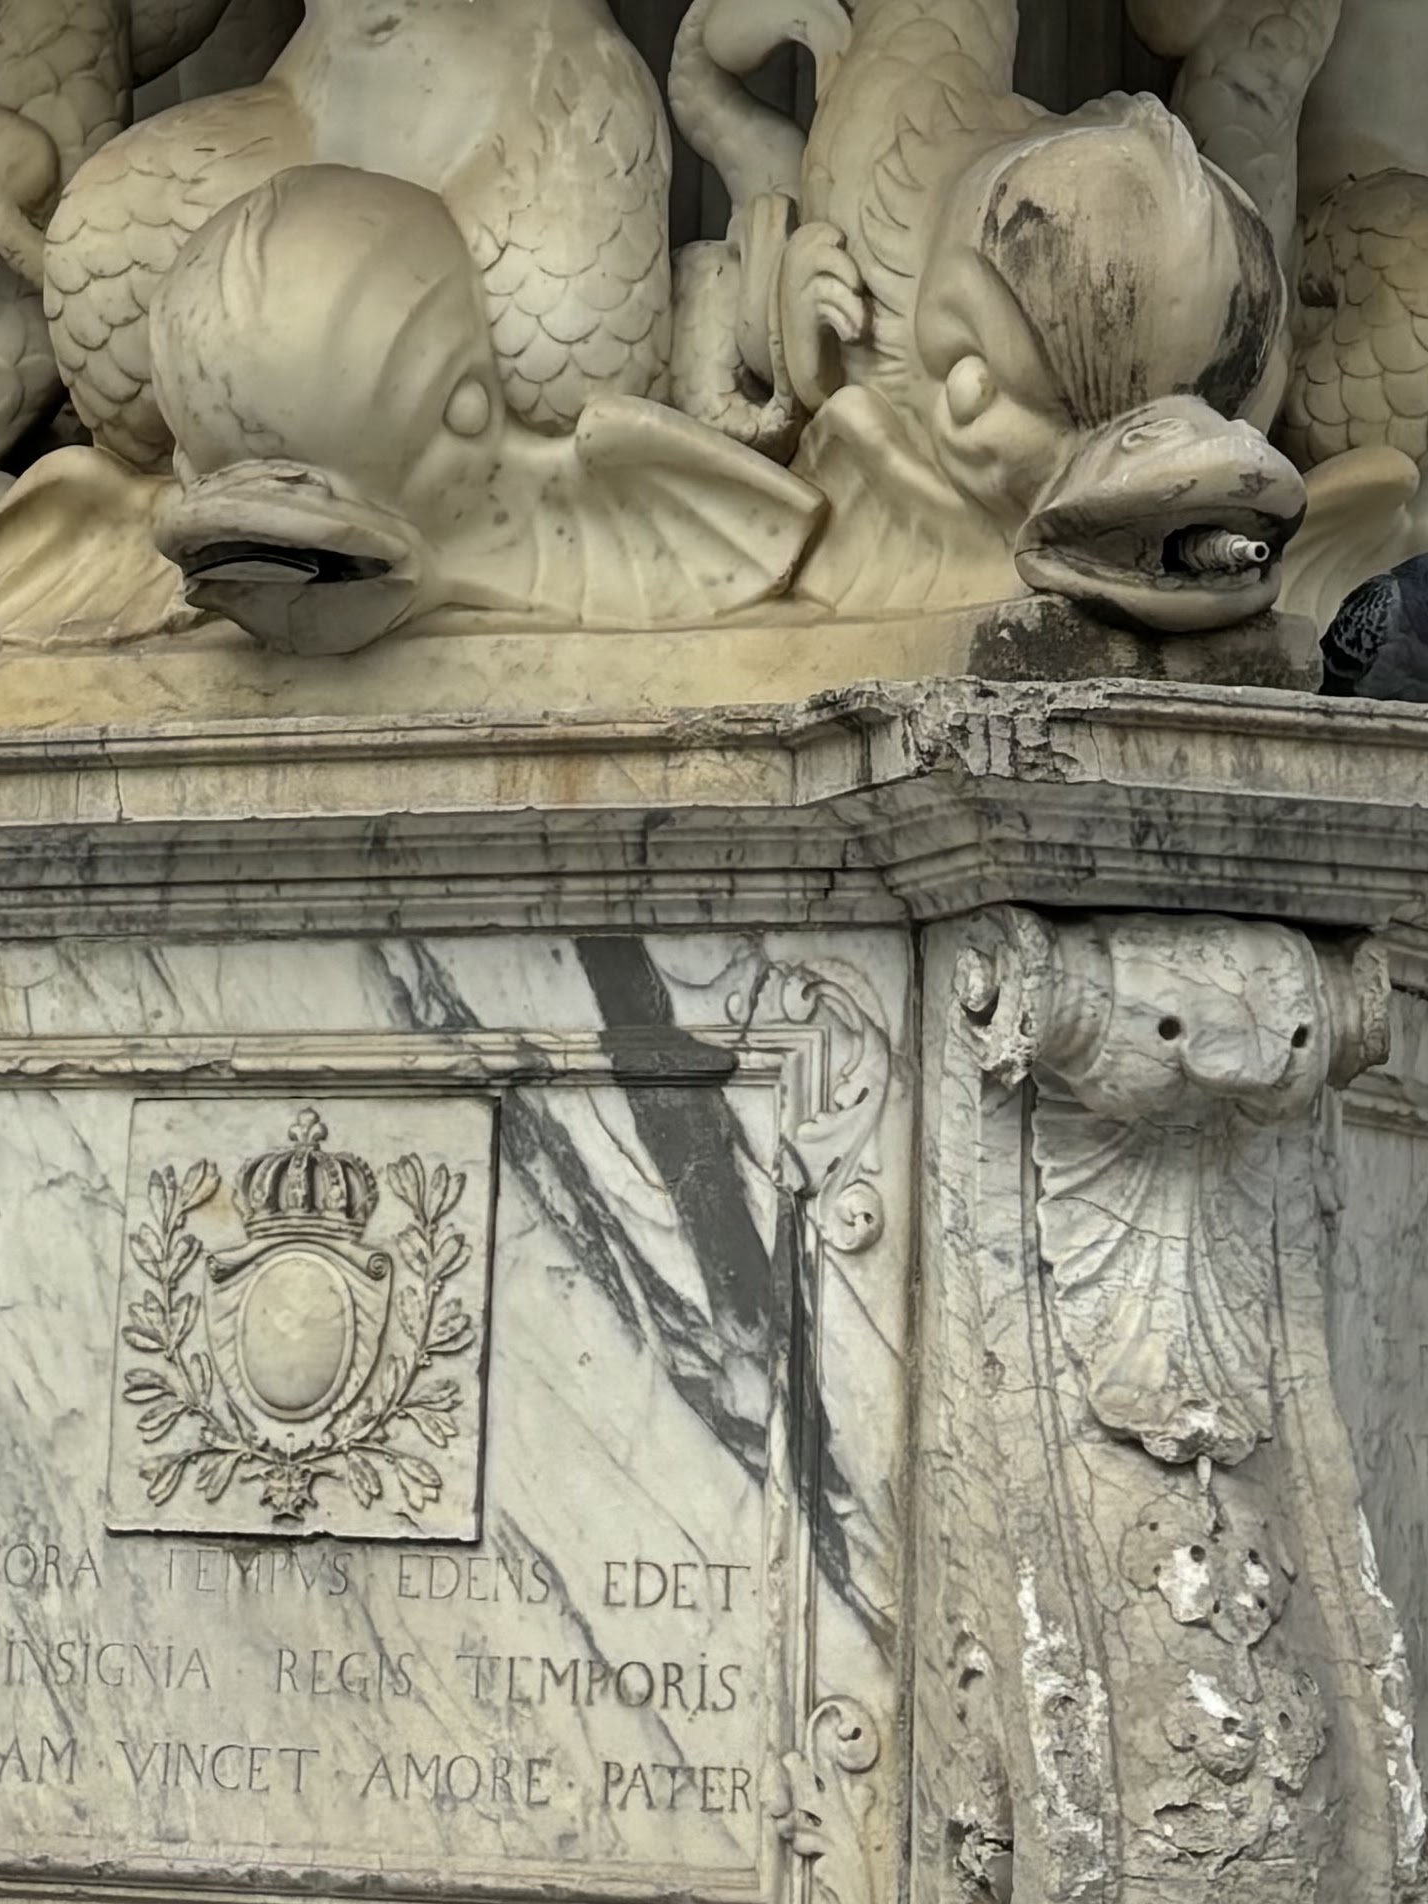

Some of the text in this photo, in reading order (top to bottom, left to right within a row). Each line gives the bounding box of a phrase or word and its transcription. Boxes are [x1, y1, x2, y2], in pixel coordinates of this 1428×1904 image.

[603, 1559, 752, 1612] EDET
[3, 1628, 212, 1690] INSIGNIA
[276, 1648, 416, 1701] REGIS
[455, 1652, 743, 1713] TEMPORIS
[115, 1739, 321, 1795] VINCET
[359, 1751, 554, 1808] AMORE
[602, 1758, 754, 1814] PATER
